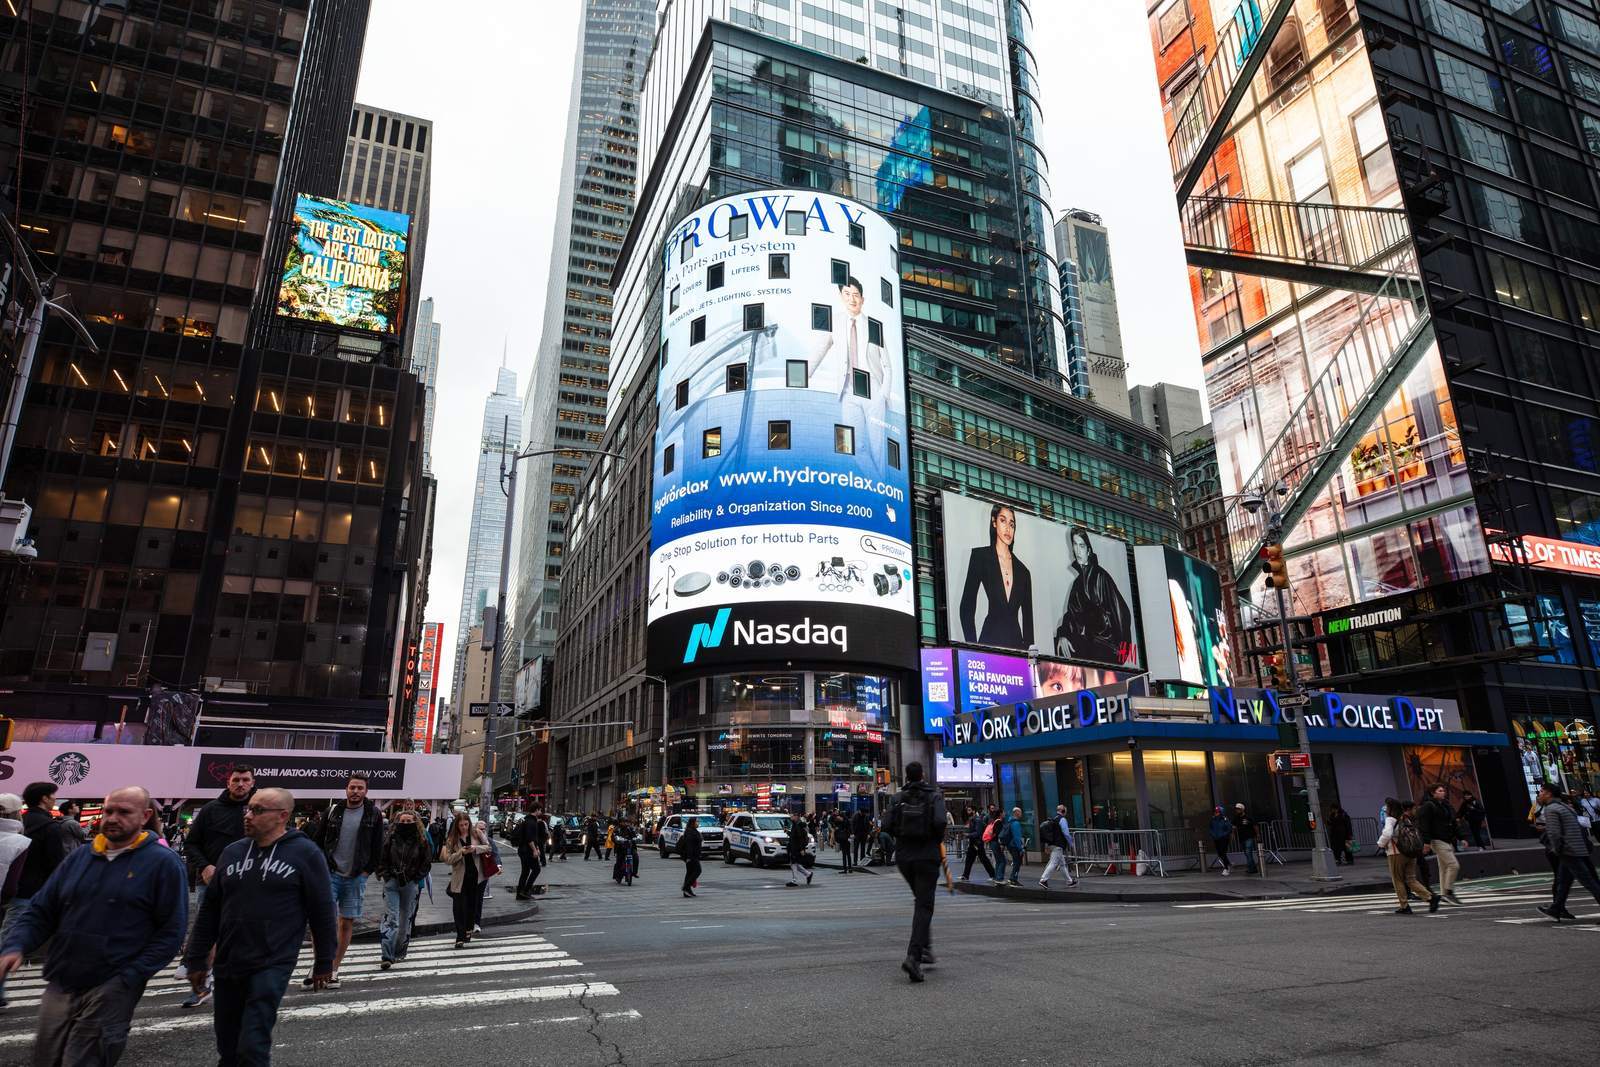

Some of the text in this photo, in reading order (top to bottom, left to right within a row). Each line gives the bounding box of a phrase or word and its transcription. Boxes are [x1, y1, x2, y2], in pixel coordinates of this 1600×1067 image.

[309, 220, 397, 251] THE BEST DATES
[322, 240, 380, 266] ARE FROM
[682, 257, 708, 278] Parts
[711, 244, 737, 262] and
[741, 240, 796, 257] System
[301, 254, 390, 292] CALIFORNIA
[682, 264, 761, 296] COVERS LIFTERS
[698, 299, 713, 310] JETS
[717, 291, 752, 303] LIGHTING
[757, 287, 792, 296] SYSTEMS
[719, 466, 904, 503] www.hydrorelax.com
[671, 500, 873, 529] Reliability & Organization Since 2000
[673, 545, 692, 558] Stop
[694, 536, 737, 552] Solution
[741, 533, 758, 545] for
[762, 532, 804, 545] Hottub
[808, 532, 840, 545] Parts
[1534, 542, 1556, 563] OF
[733, 617, 848, 653] Nasdaq
[404, 646, 416, 699] TONY
[967, 659, 986, 670] 2026
[968, 670, 1024, 686] FAN FAVORITE
[969, 682, 1008, 696] K-DRAMA
[942, 690, 1130, 747] NEW YORK POLICE DEPT
[1209, 687, 1264, 724] NEW
[1322, 692, 1394, 729] POLICE
[1390, 696, 1444, 731] DEPT
[320, 769, 349, 779] STORE
[372, 769, 398, 778] YORK
[226, 857, 296, 879] OLD NAVY
